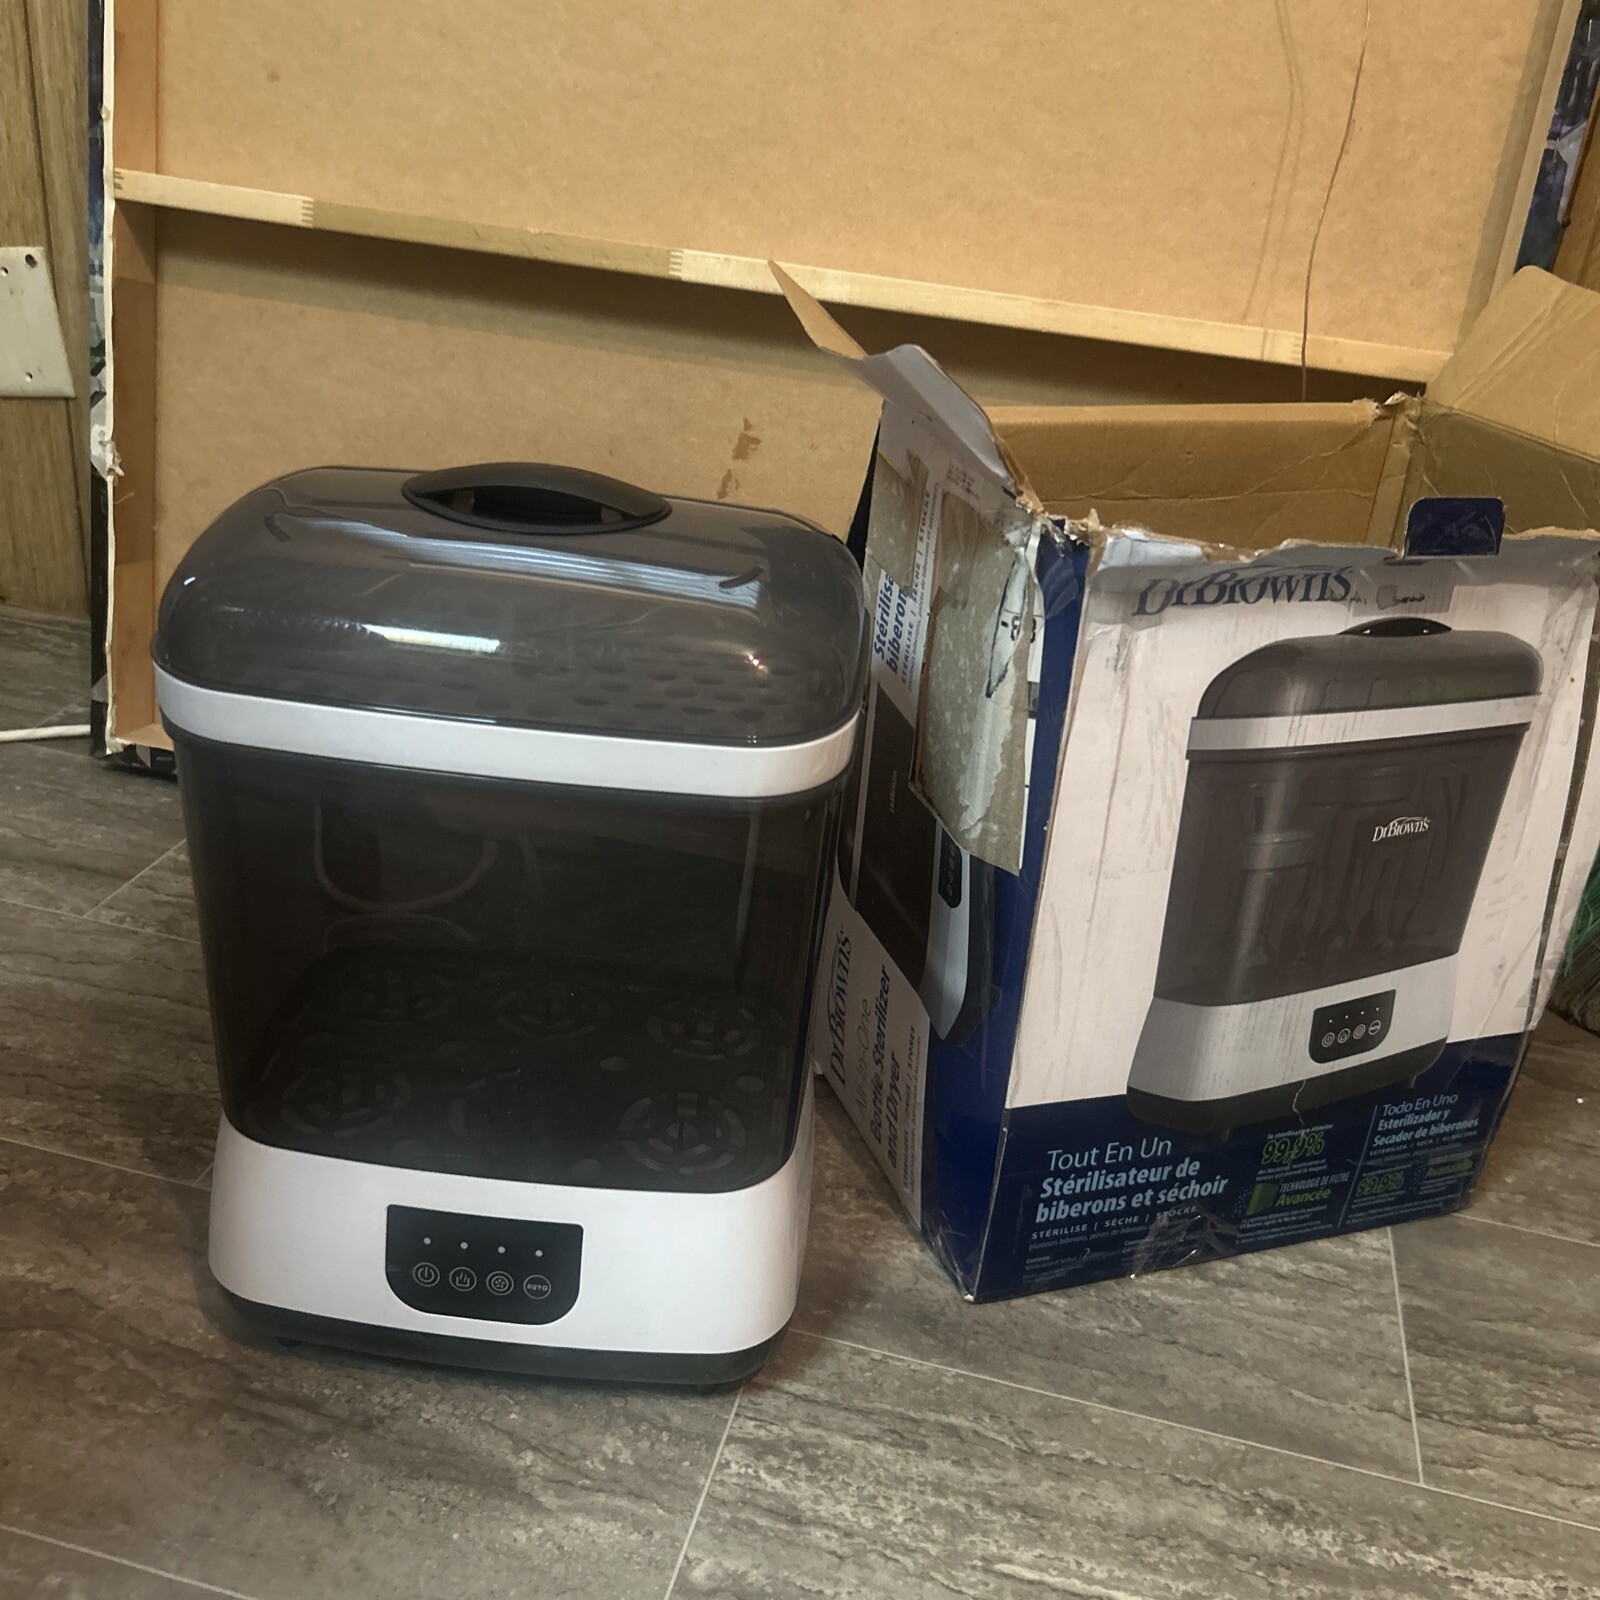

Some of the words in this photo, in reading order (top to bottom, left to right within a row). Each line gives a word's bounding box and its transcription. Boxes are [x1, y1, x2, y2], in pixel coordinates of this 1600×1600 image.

[873, 963, 890, 1071] Sterilizer
[886, 1051, 902, 1122] Dryer
[1377, 1109, 1442, 1132] Esterilizador
[1383, 1101, 1413, 1117] Todo
[1414, 1097, 1431, 1111] En
[1433, 1094, 1459, 1107] Uno
[886, 1114, 897, 1169] and
[1372, 1130, 1415, 1147] Secador
[1414, 1126, 1428, 1139] de
[1429, 1117, 1480, 1136] biberones
[1047, 1147, 1099, 1171] Tout
[1104, 1142, 1133, 1164] En
[1140, 1136, 1172, 1158] Un
[1040, 1164, 1172, 1198] Stérilisateur
[1175, 1157, 1201, 1178] de
[1035, 1199, 1127, 1223] biberons
[1131, 1188, 1154, 1208] et
[1156, 1175, 1229, 1204] séchoir
[1275, 1187, 1332, 1207] Avancée
[527, 1283, 548, 1291] AUTO
